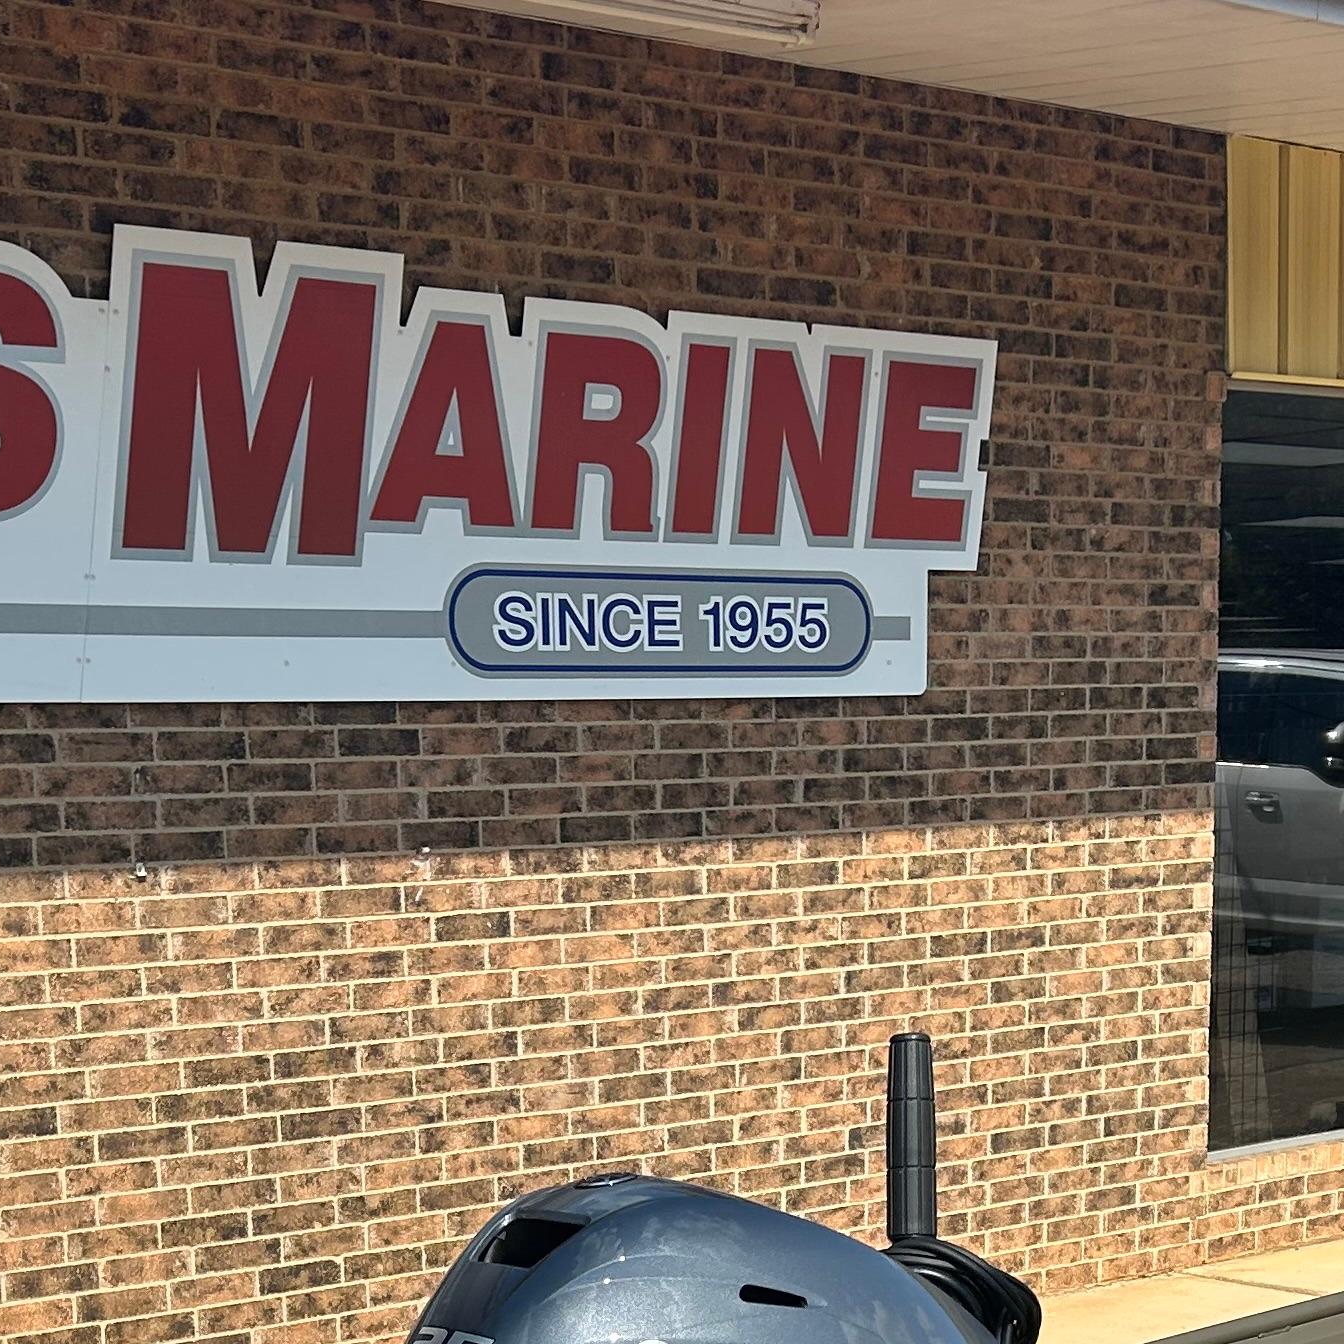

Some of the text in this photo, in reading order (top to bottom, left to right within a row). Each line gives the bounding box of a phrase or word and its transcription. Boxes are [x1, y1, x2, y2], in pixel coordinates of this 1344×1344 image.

[119, 260, 979, 557] MARINE
[496, 594, 829, 650] SINCE 1955
